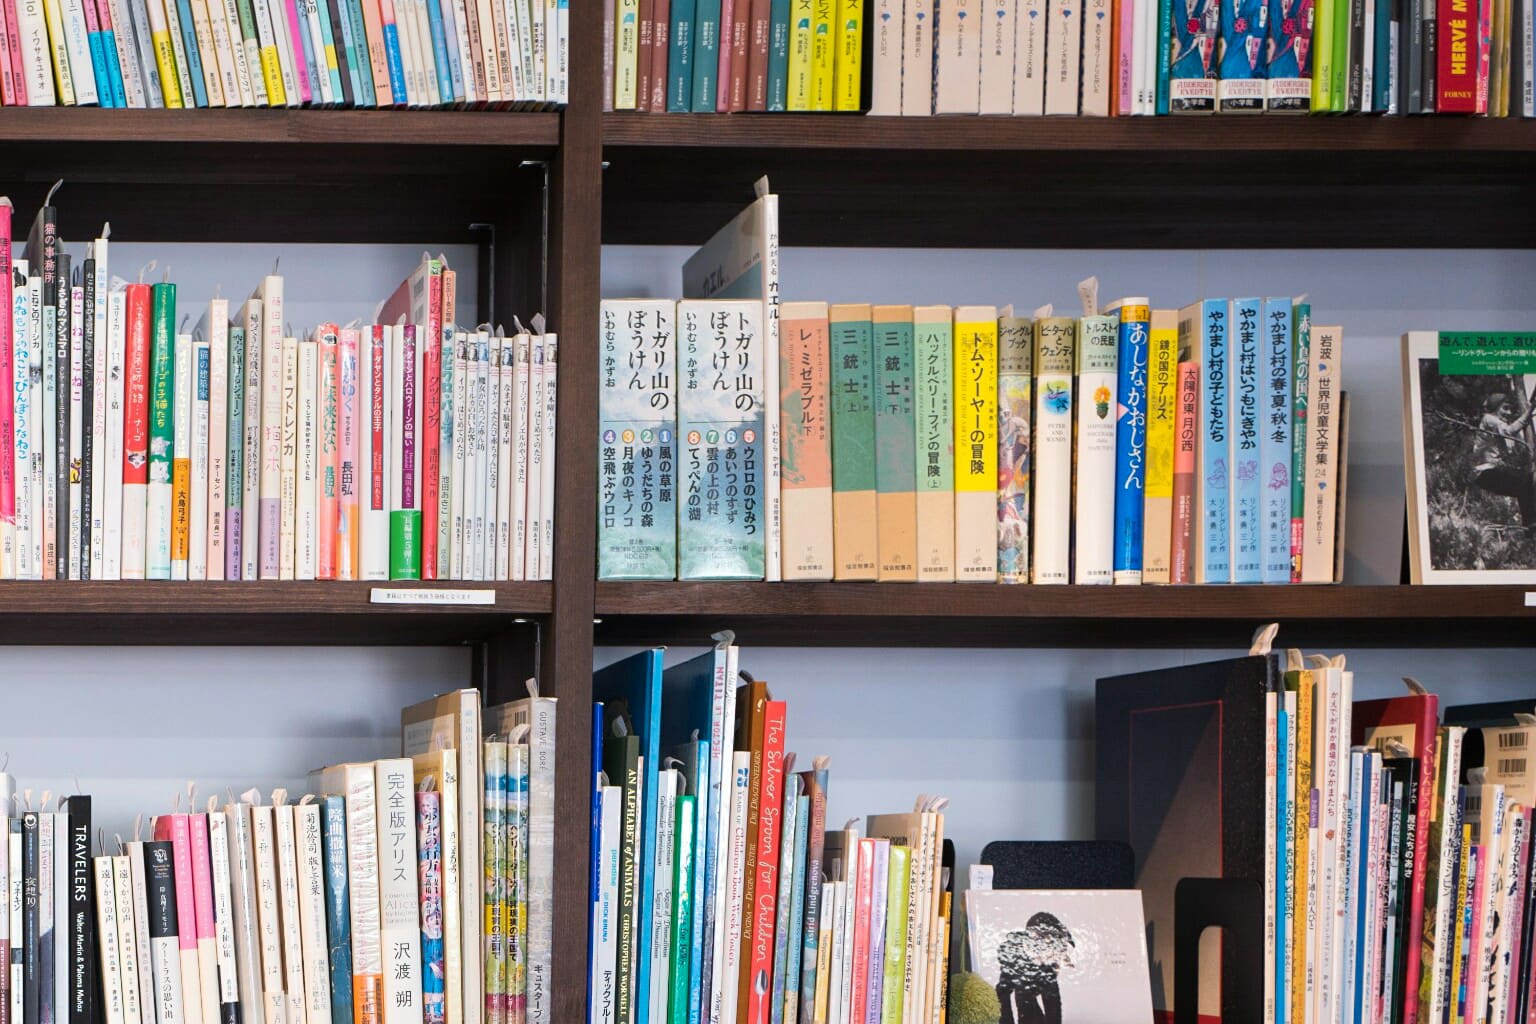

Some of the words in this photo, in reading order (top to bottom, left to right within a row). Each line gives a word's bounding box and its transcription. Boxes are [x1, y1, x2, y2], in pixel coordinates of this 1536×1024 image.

[44, 223, 56, 284] 猫の事務所
[605, 311, 615, 351] いわむら
[627, 311, 647, 391] ぼうけん
[686, 312, 697, 353] いわむら
[710, 312, 731, 391] ぼうけん
[1008, 338, 1027, 349] ブック
[1320, 334, 1333, 360] 岩波
[605, 357, 615, 388] かずお
[650, 311, 669, 411] トガリ山の
[687, 358, 698, 390] かずお
[736, 312, 754, 412] トガリ山の
[799, 328, 815, 424] レ・ミゼラブル
[843, 329, 858, 394] 三銃士
[885, 332, 900, 395] 三銃士
[1157, 340, 1170, 420] 鏡の国のアリス
[1208, 311, 1224, 443] やかまし村の子どもたち
[1239, 308, 1256, 450] やかまし村はいつもにぎやか
[1270, 311, 1287, 443] やかまし村の春・夏・秋・冬
[926, 333, 940, 477] ハックルベリー・フィンの冒険
[970, 333, 985, 475] トム・ソーヤーの冒険
[1124, 323, 1148, 491] あしながおじさん
[1183, 368, 1195, 414] 太陽の東
[1181, 417, 1193, 452] 月の西
[1316, 376, 1331, 466] 世界児童文学集
[341, 460, 353, 495] 長田弘
[603, 447, 616, 528] 空飛ぶウロロ
[623, 447, 634, 528] 月夜のキノコ
[641, 447, 654, 528] ゆうだちの森
[659, 447, 672, 503] 風の草原
[688, 448, 701, 521] てっぺんの湖
[706, 447, 719, 515] 雲の上の村
[725, 447, 738, 524] あいつのすず
[743, 447, 756, 536] ウロロのひみつ
[713, 666, 725, 701] TITAN
[712, 727, 720, 759] HECTOR
[767, 715, 783, 745] The
[627, 768, 637, 785] AN
[765, 750, 785, 802] Silver
[386, 772, 407, 882] 完全版アリス
[624, 788, 636, 844] ALPHABET
[761, 806, 779, 856] Spoon
[75, 824, 86, 901] TRAVELERS
[624, 846, 634, 856] of
[759, 861, 778, 890] for
[623, 857, 633, 907] ANIMALS
[76, 912, 84, 933] Walter
[76, 934, 84, 955] Martin
[620, 914, 630, 972] CHRISTOPHER
[755, 894, 776, 963] Children
[806, 914, 818, 945] Astrid
[393, 942, 411, 980] 沢渡
[395, 990, 412, 1008] 朔
[620, 975, 628, 1016] WORMELL
